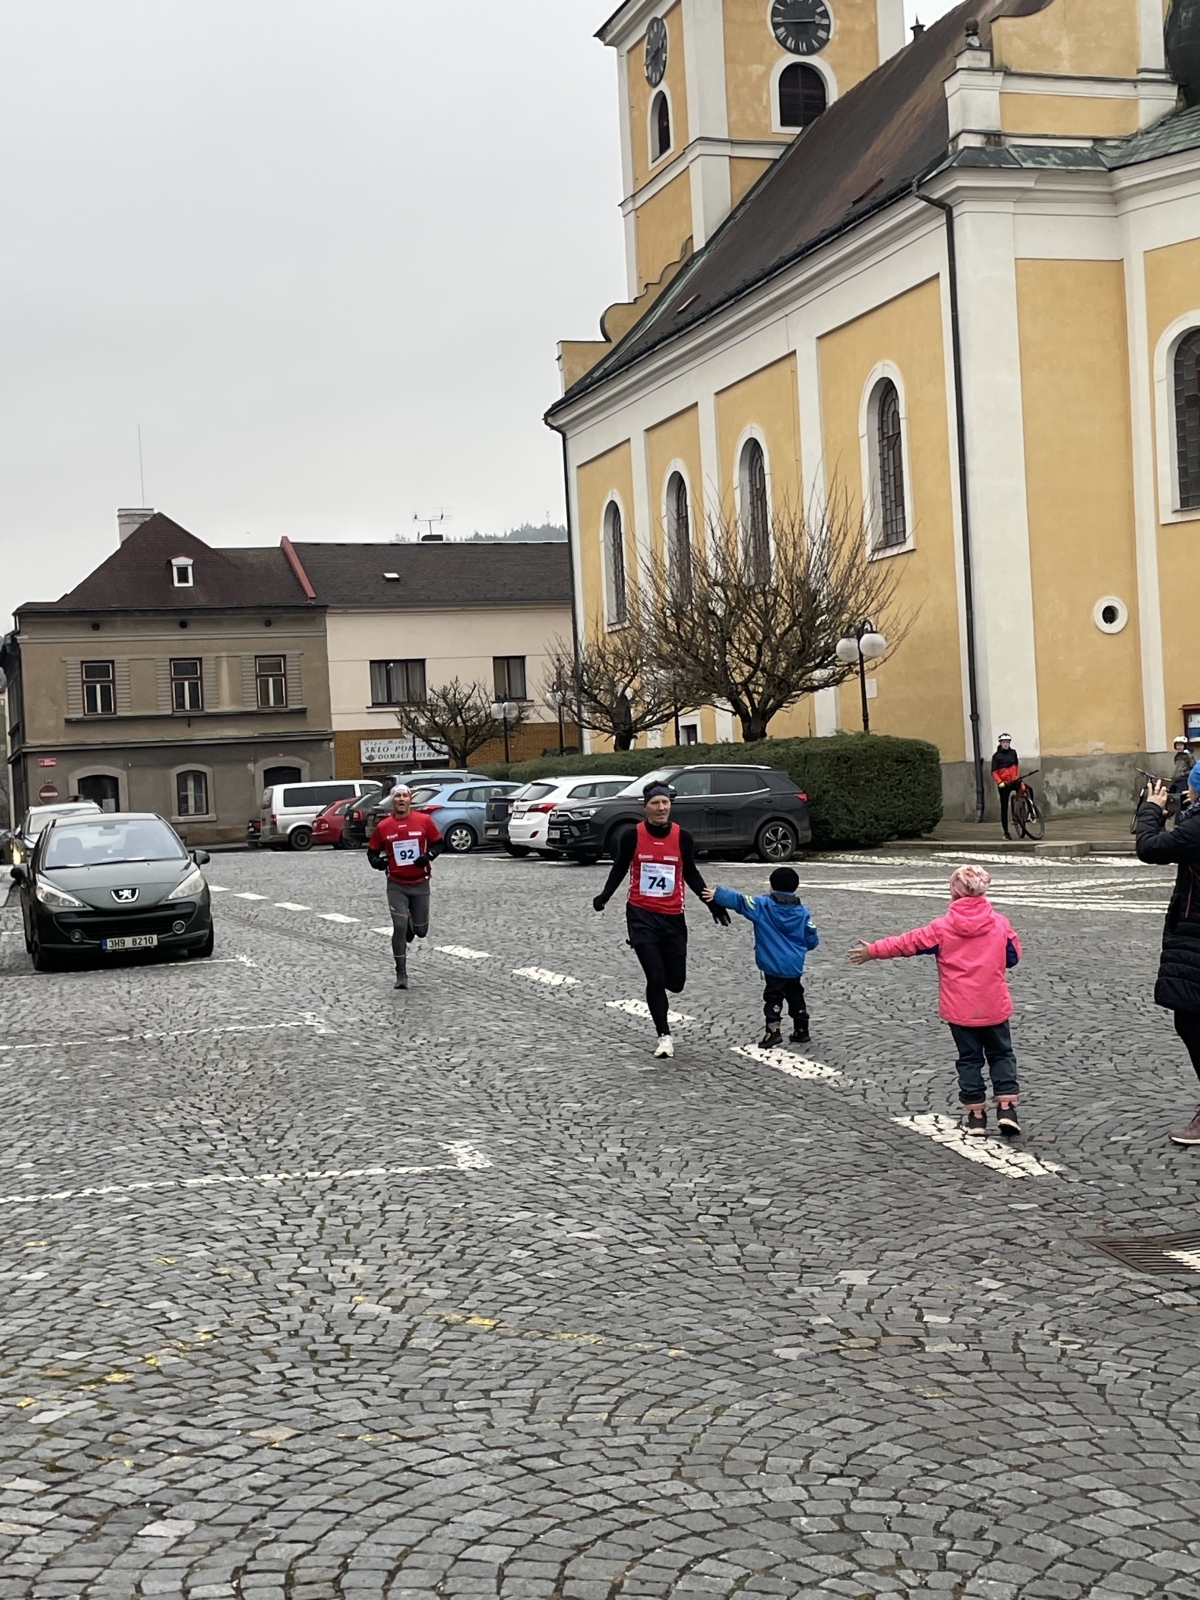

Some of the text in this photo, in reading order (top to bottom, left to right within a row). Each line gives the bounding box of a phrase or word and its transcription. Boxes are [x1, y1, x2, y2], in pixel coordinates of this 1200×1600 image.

[399, 849, 415, 860] 92
[648, 876, 667, 891] 74
[108, 935, 154, 949] 3H9 8210
